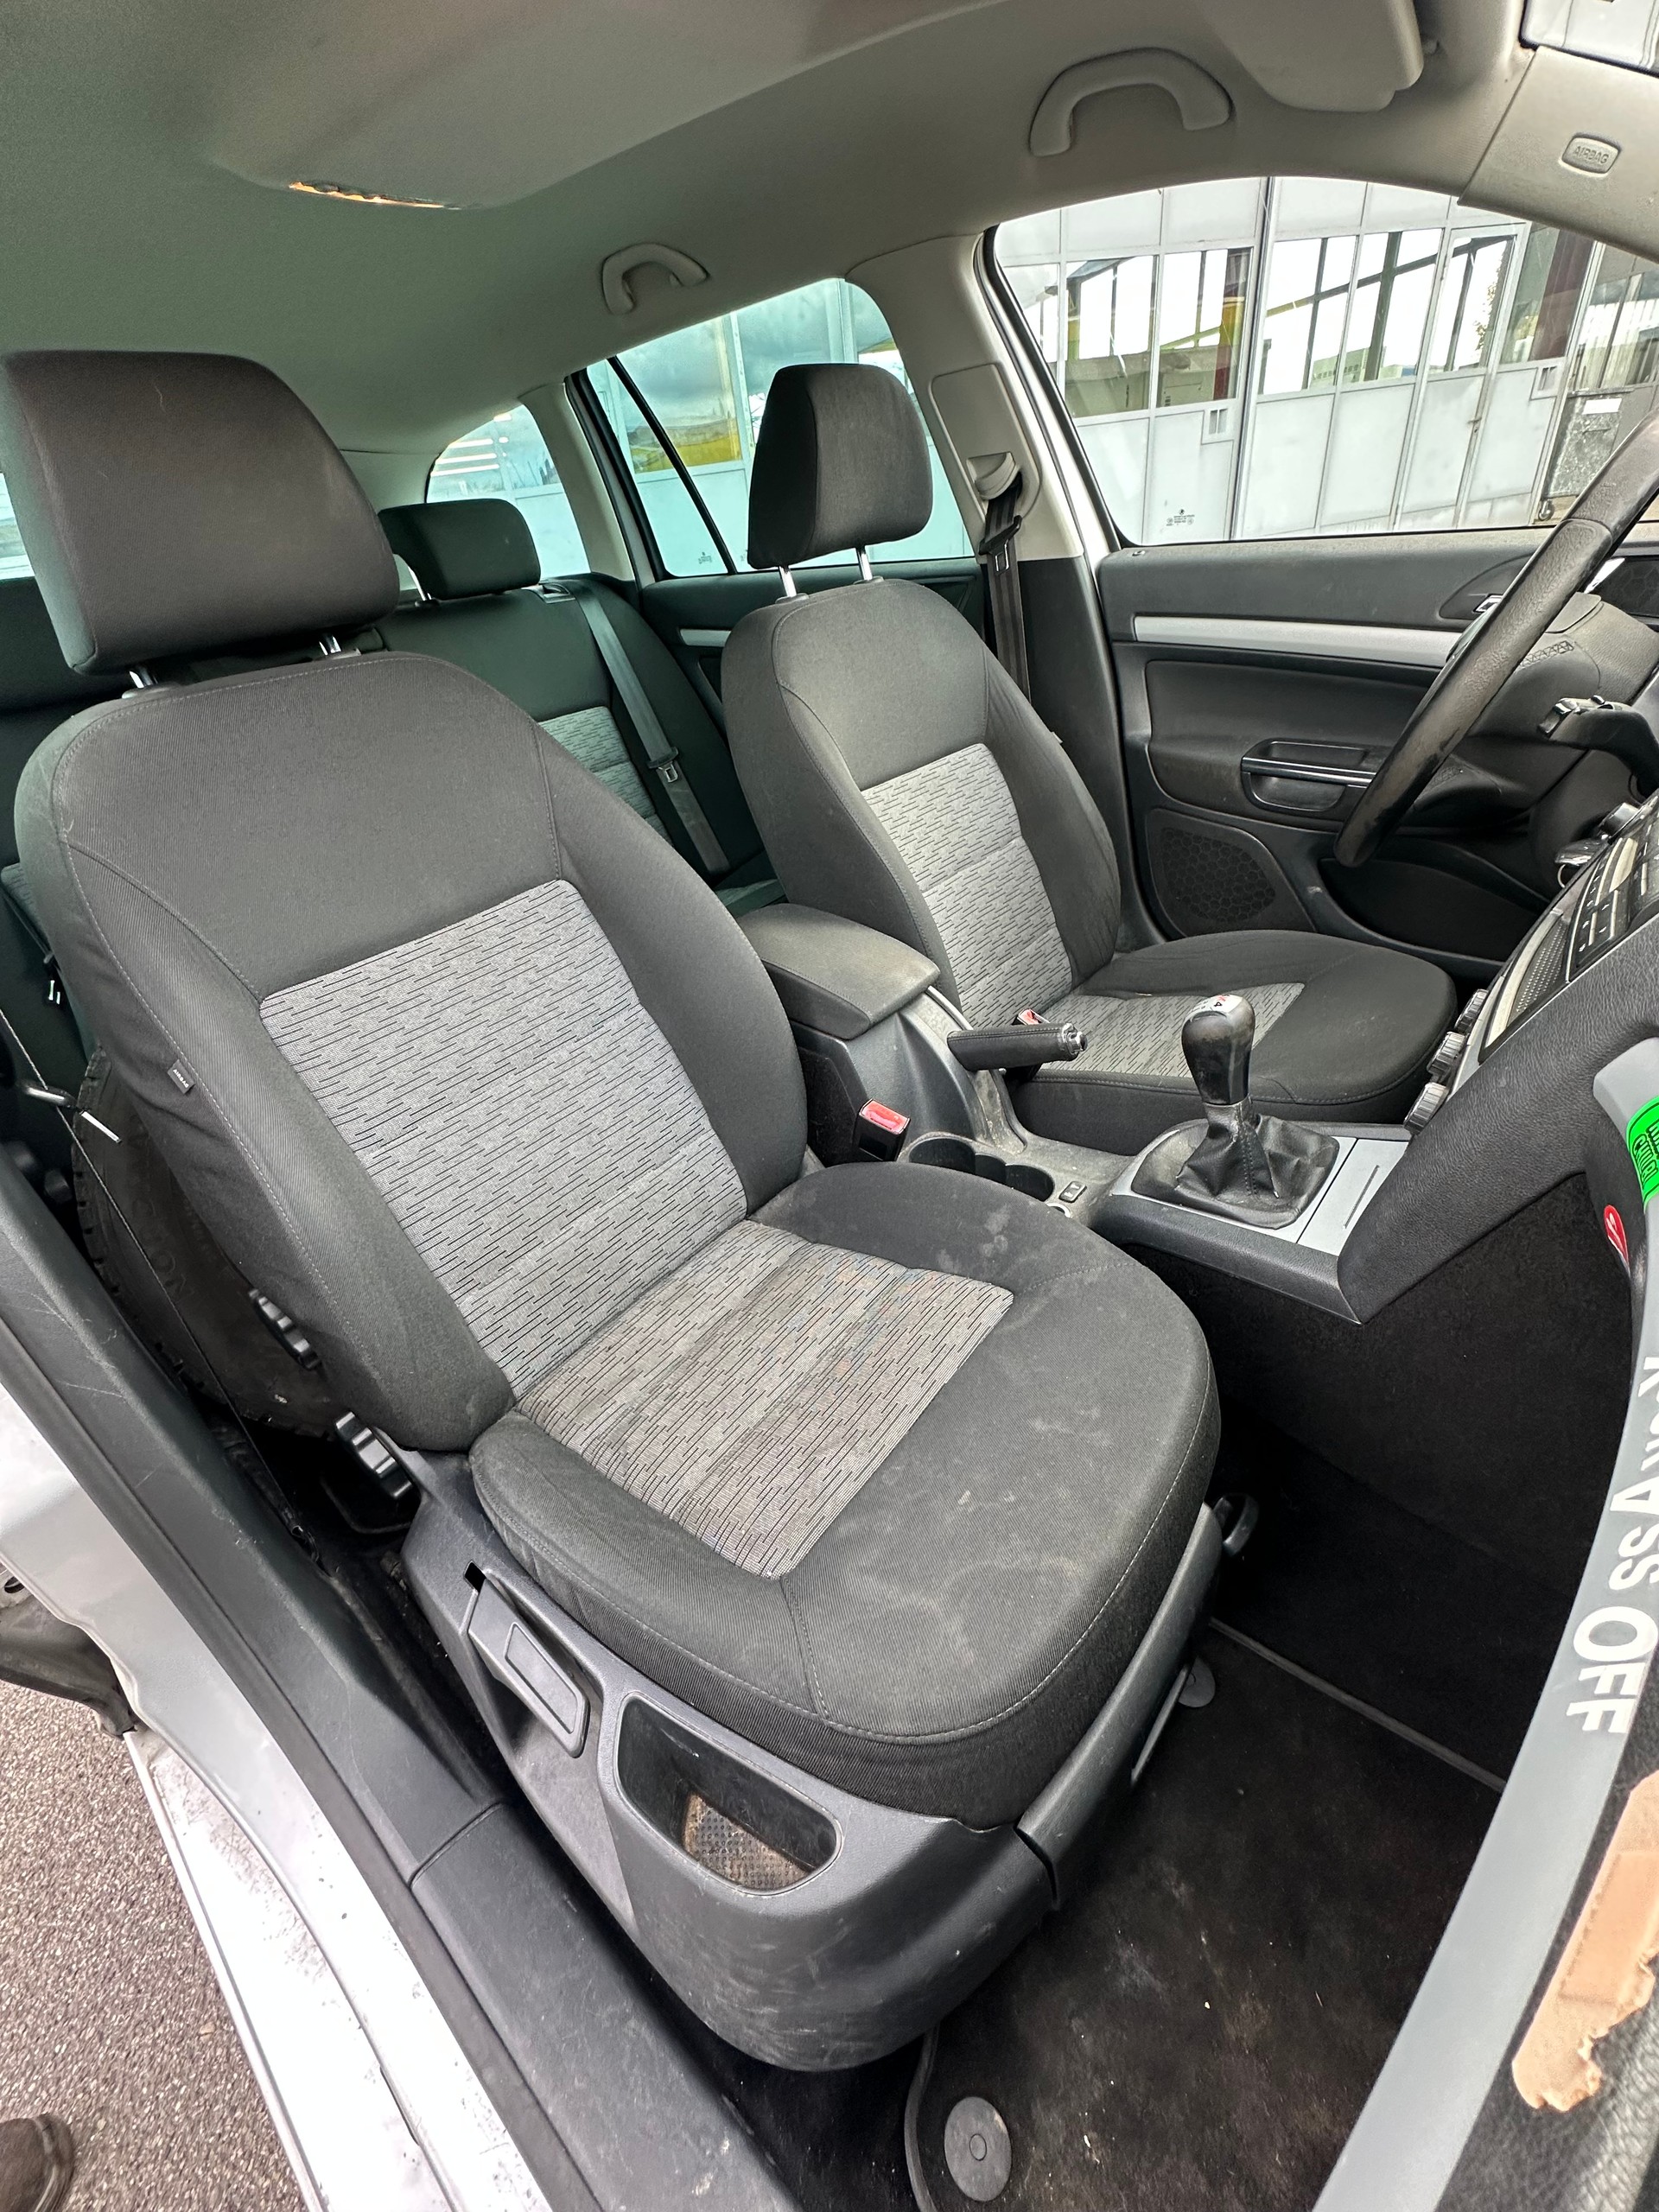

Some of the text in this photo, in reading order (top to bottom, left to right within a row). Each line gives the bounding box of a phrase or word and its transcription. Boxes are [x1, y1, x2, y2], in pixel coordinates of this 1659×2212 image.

[1573, 145, 1610, 164] AIRBAG
[172, 1068, 189, 1089] AIRBAG
[1566, 1605, 1659, 1733] OFF
